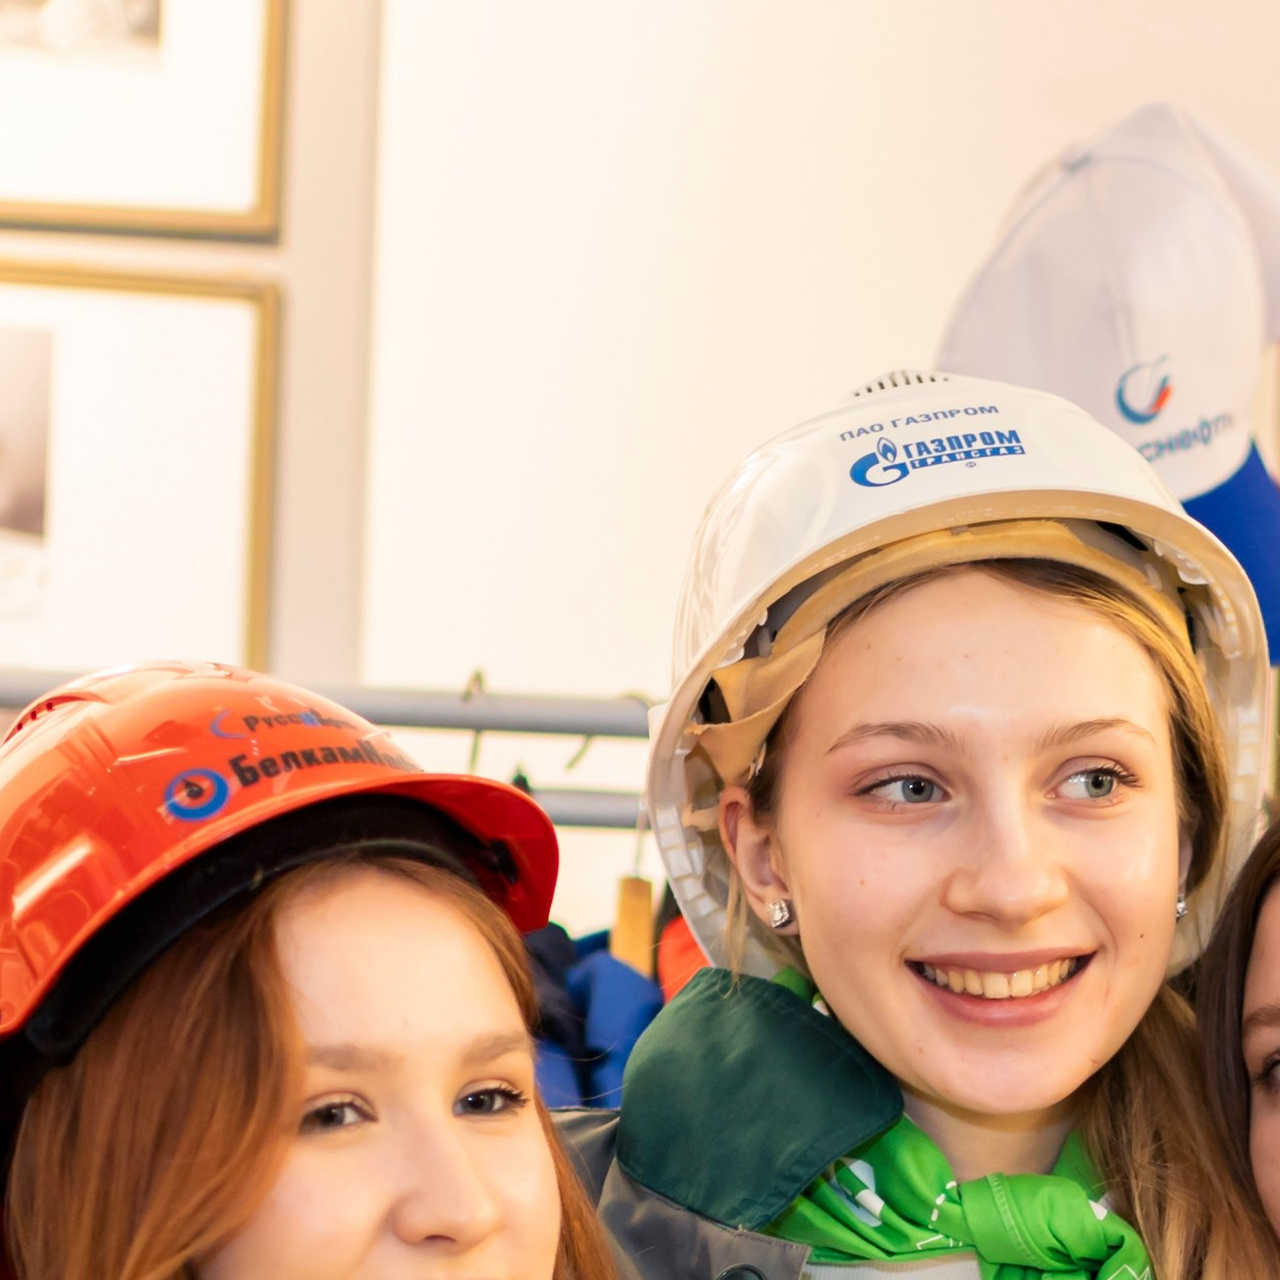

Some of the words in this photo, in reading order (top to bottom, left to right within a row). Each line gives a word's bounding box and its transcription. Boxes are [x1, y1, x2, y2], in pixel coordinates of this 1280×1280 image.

[839, 423, 885, 441] ПАО
[891, 405, 1000, 428] ГАЗПРОМ
[902, 430, 1022, 459] ГАЗПРОМ
[911, 446, 1024, 468] ТРАНСГАЗ
